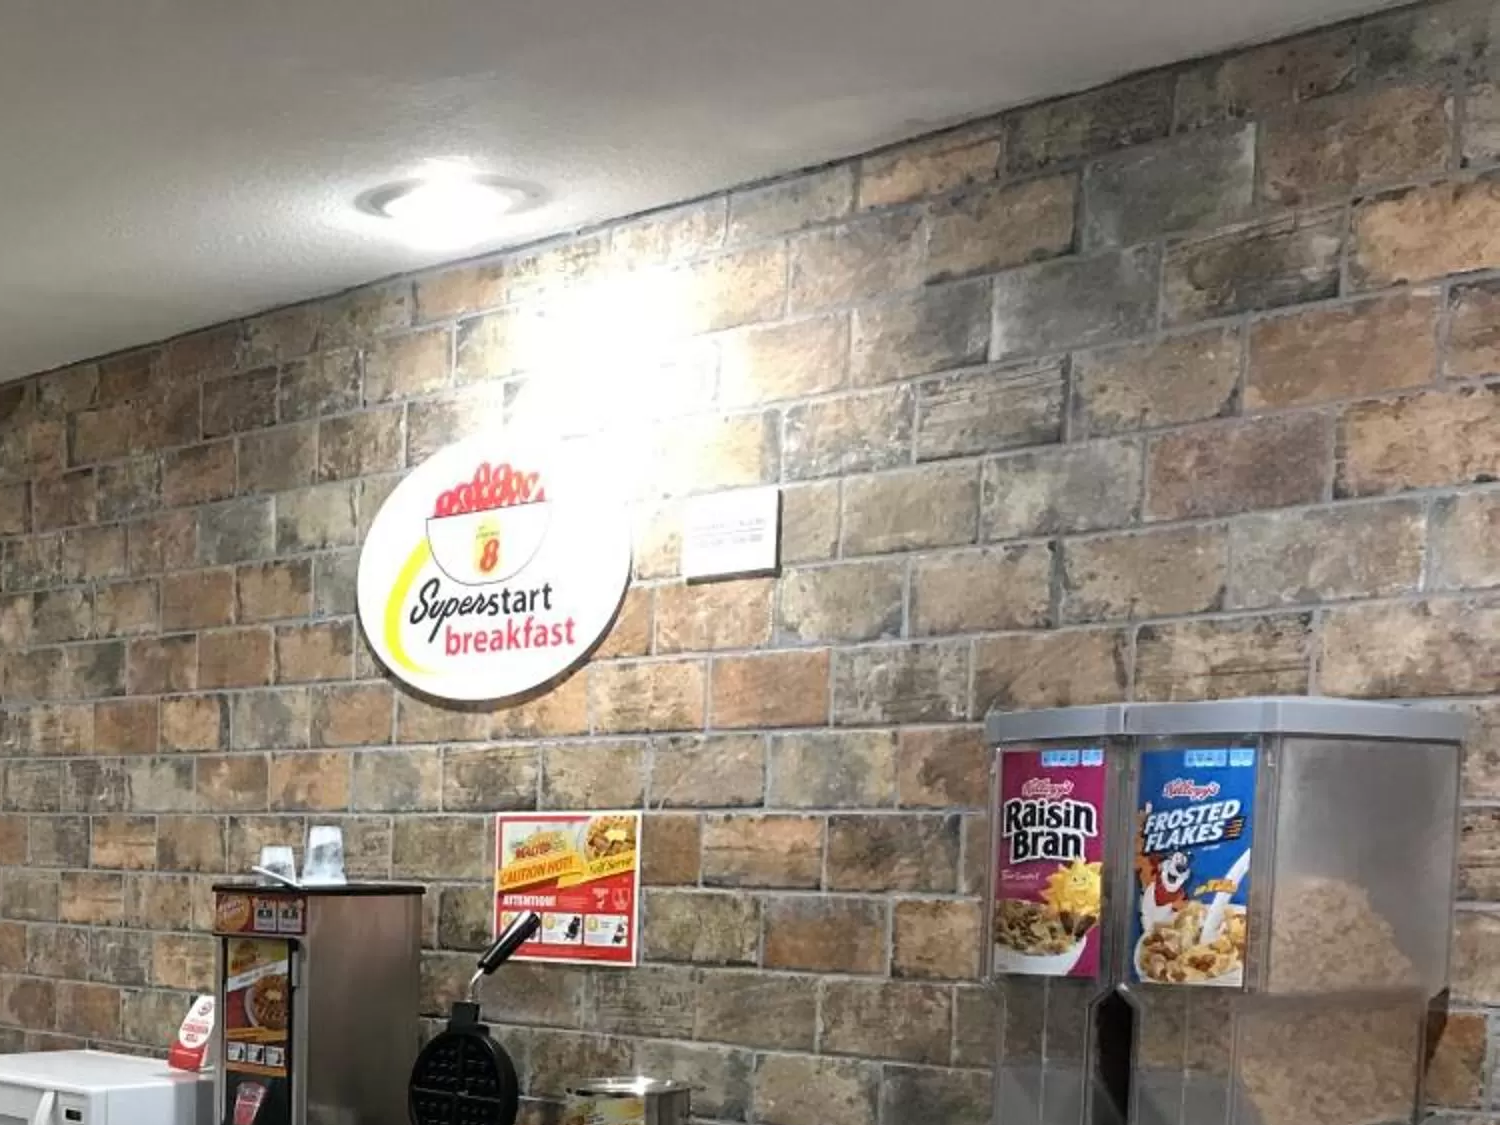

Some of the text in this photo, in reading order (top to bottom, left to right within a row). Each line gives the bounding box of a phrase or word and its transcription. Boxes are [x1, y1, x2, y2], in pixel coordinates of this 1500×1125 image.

[479, 537, 499, 573] 8
[409, 577, 553, 643] Superstart
[445, 615, 576, 656] breakfast
[1005, 799, 1095, 834] Raisin
[1144, 799, 1241, 835] FROSTED
[1013, 829, 1082, 861] Bran
[1145, 821, 1224, 853] FLAKES
